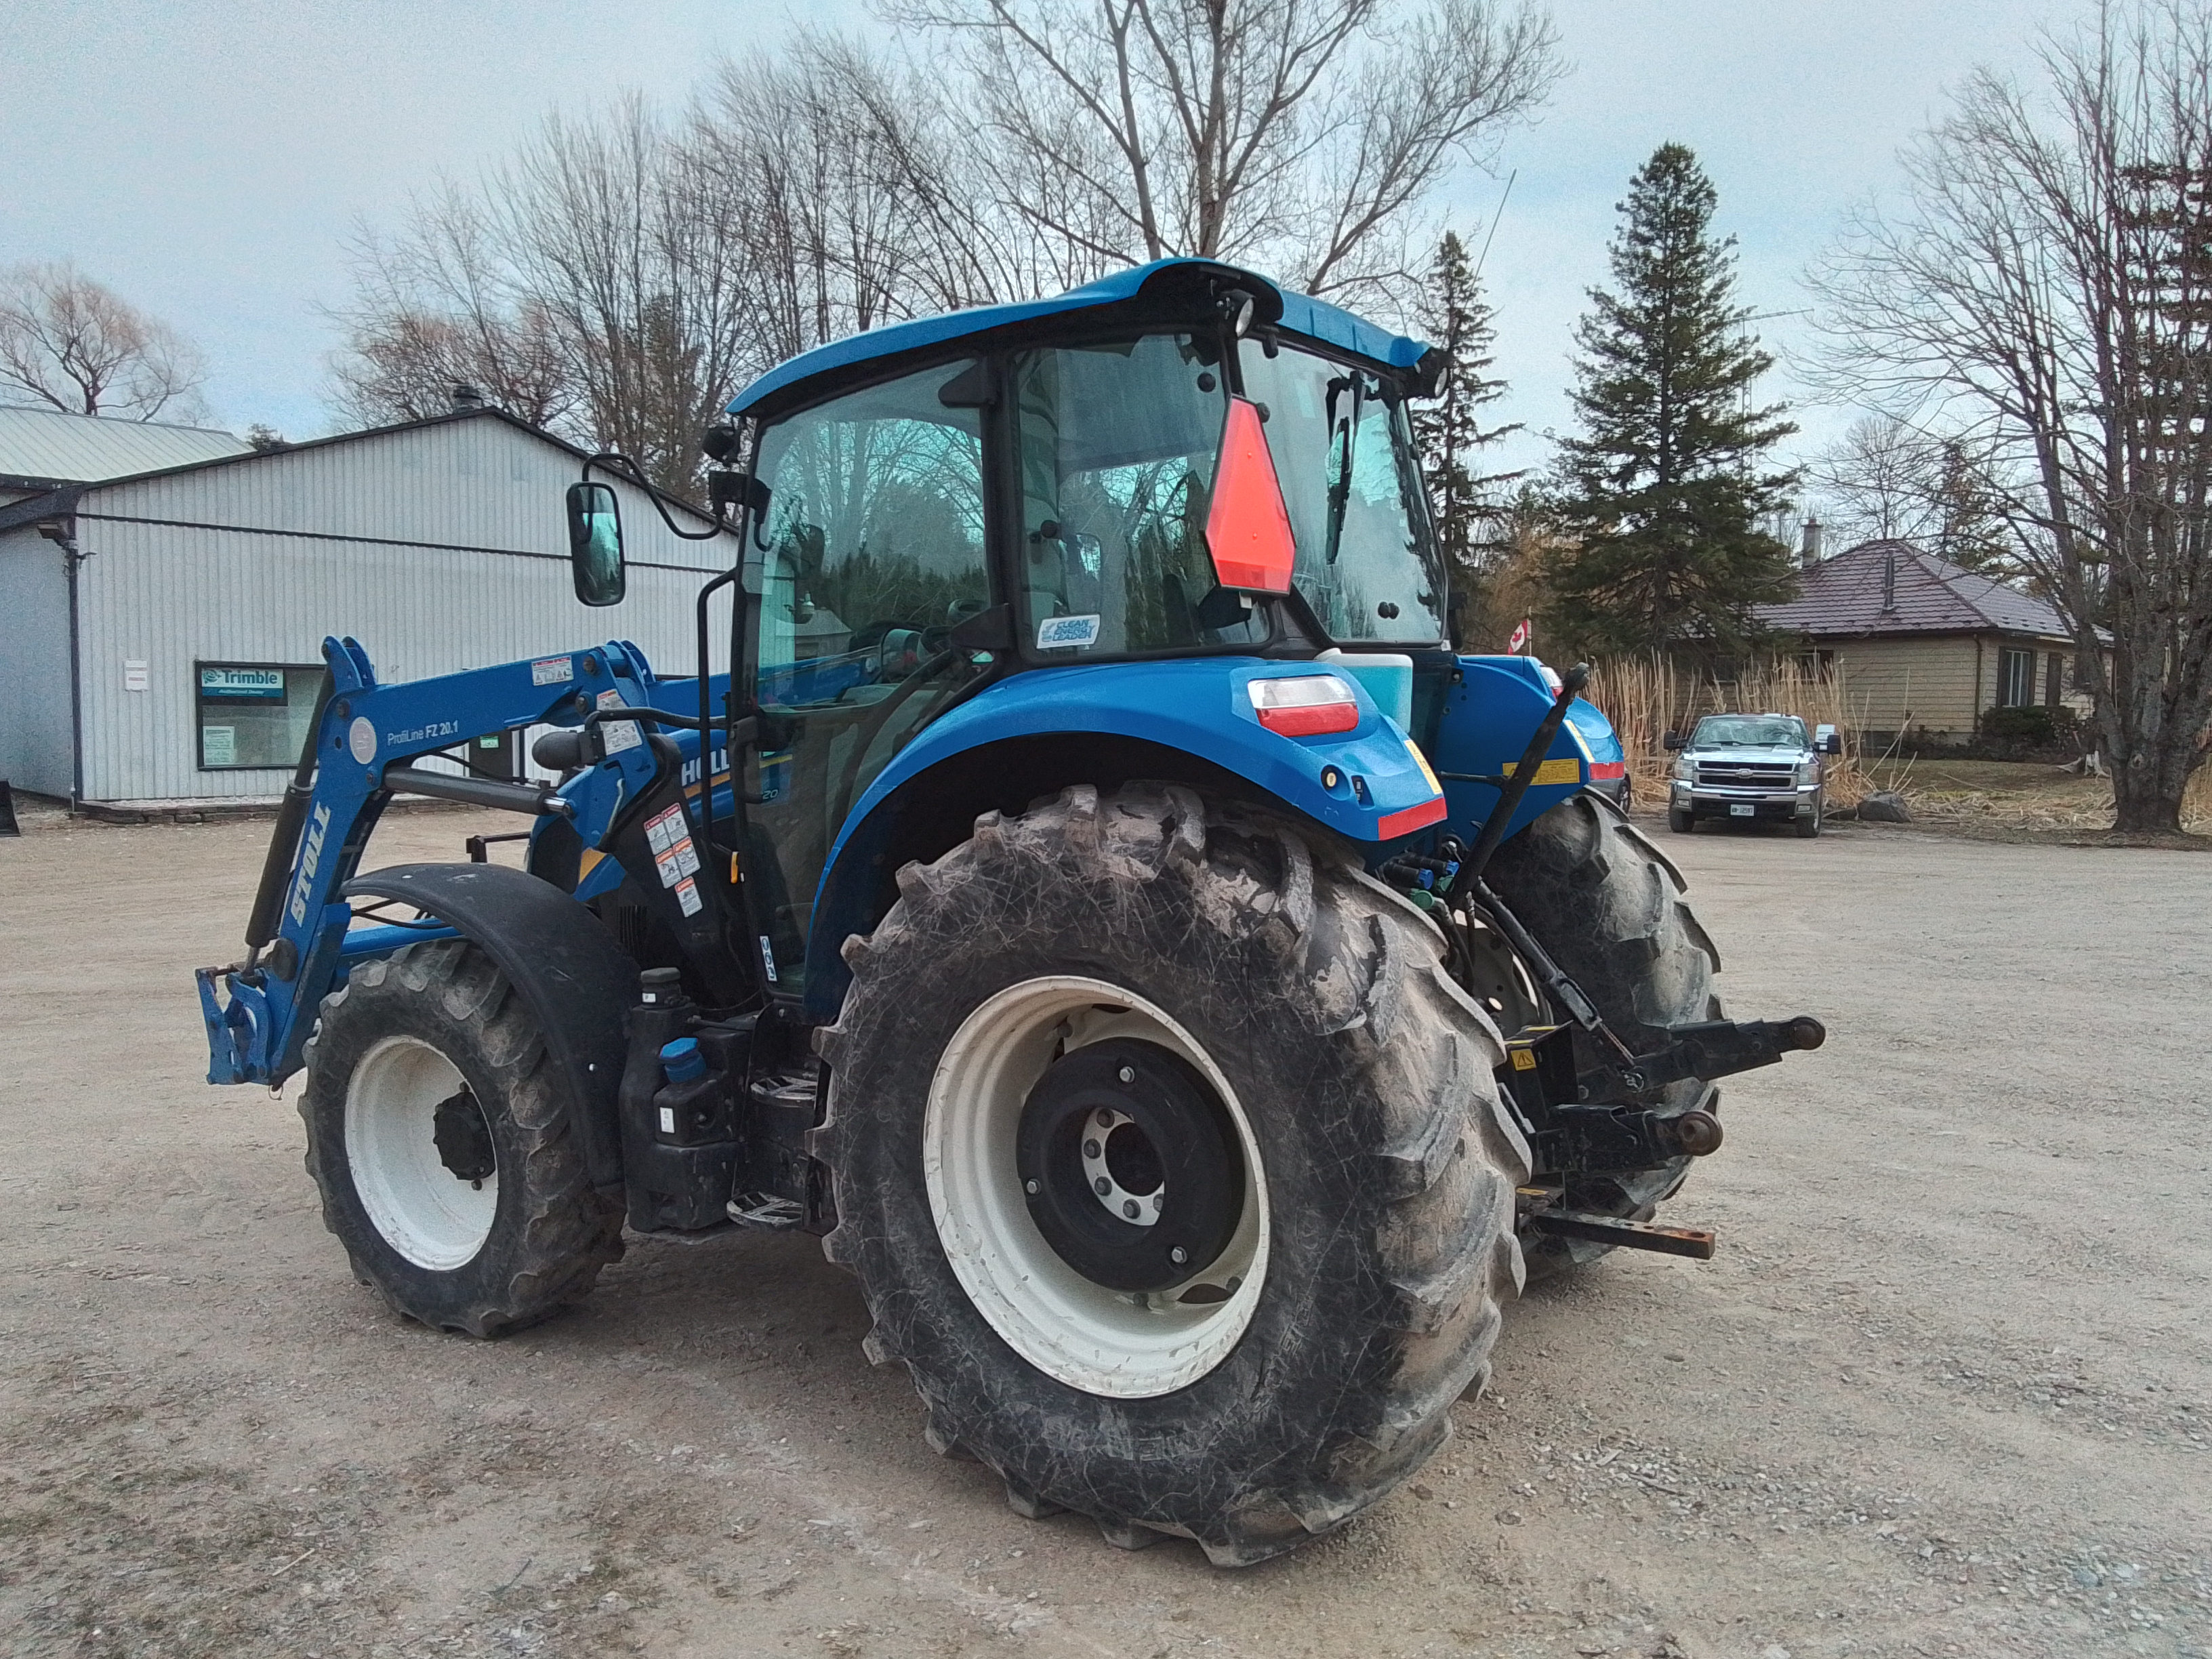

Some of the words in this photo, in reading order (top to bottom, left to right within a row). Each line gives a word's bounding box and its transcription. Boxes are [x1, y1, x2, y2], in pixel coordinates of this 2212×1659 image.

[1057, 619, 1090, 628] CLEAN
[1054, 625, 1096, 635] ENERGY
[1052, 632, 1092, 641] LEADER
[222, 670, 278, 684] Trimble
[425, 724, 438, 739] FZ
[439, 720, 458, 736] 20.1
[291, 800, 331, 928] STOLL
